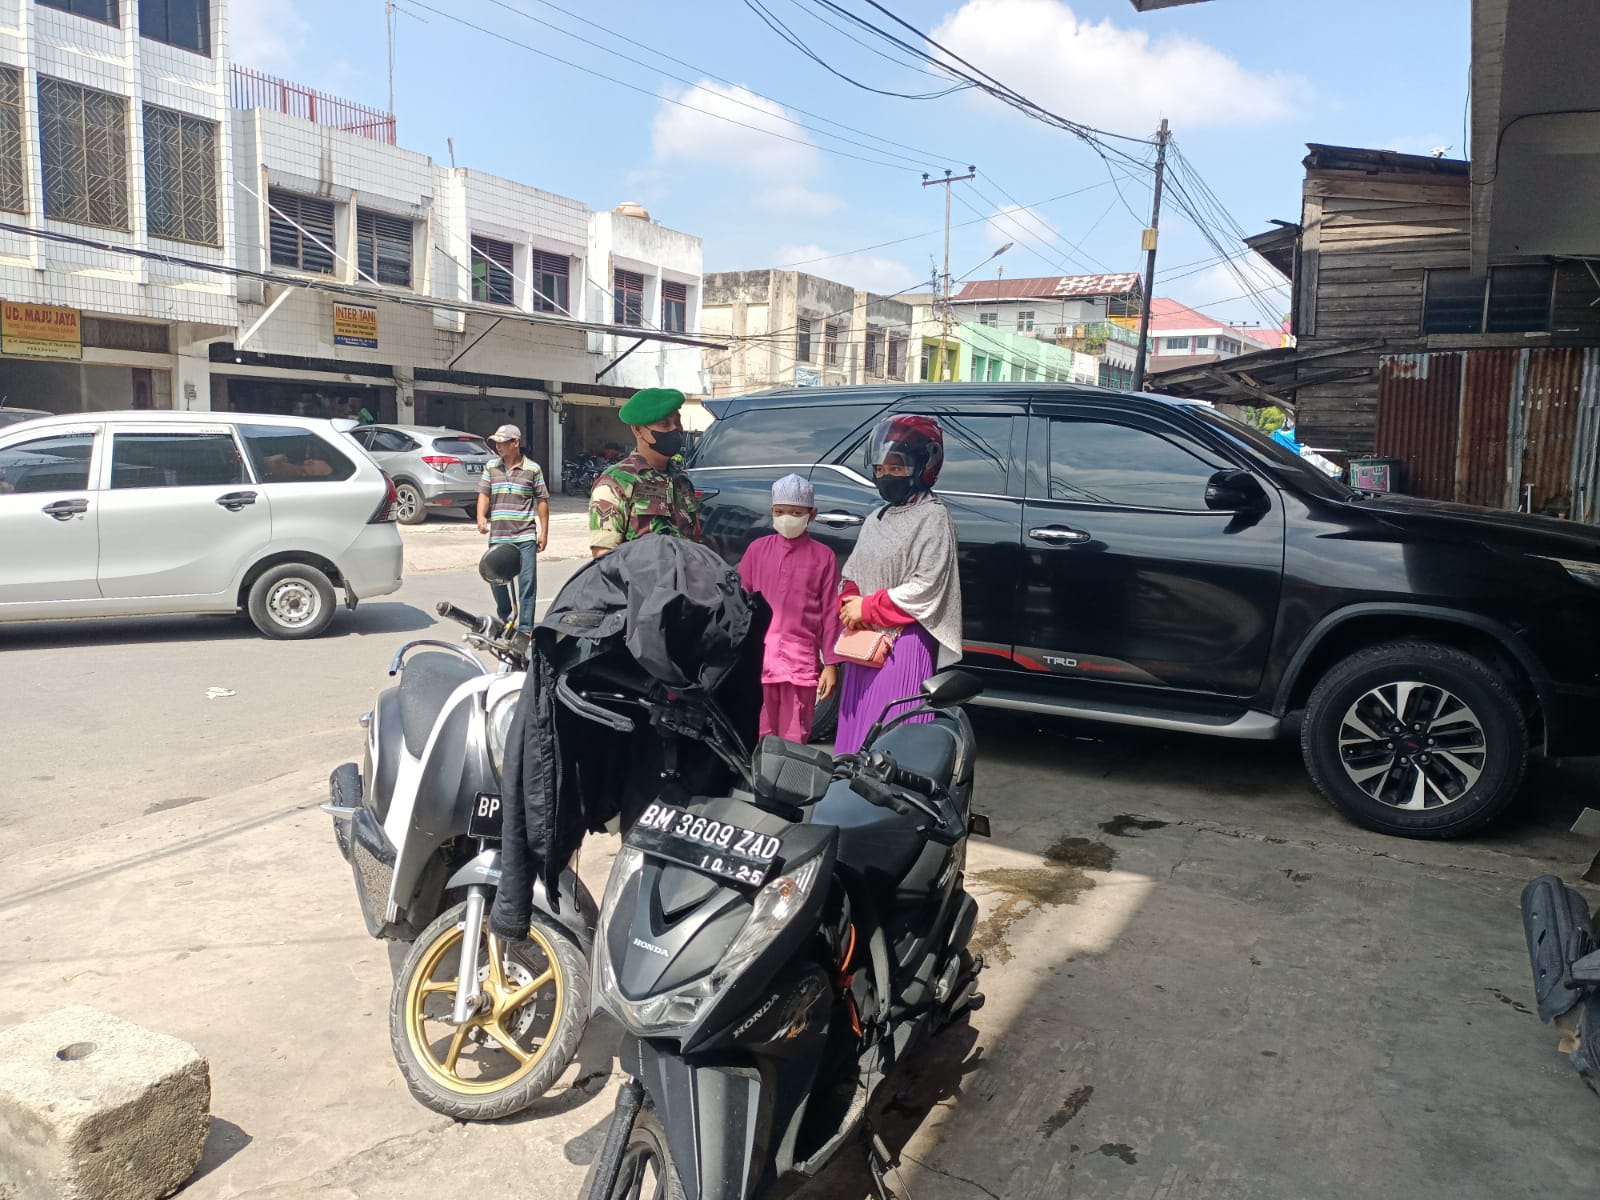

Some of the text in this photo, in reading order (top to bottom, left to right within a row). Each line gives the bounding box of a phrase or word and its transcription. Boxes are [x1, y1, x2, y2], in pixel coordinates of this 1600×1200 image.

[5, 305, 77, 327] UD. MAJU JAYA
[335, 305, 376, 323] INTER TANI
[1042, 655, 1077, 667] TRD
[477, 796, 500, 819] BP
[639, 804, 781, 860] BM 3609 ZAD
[736, 865, 762, 883] 25
[633, 937, 669, 957] HONDA
[732, 993, 780, 1039] HONDA
